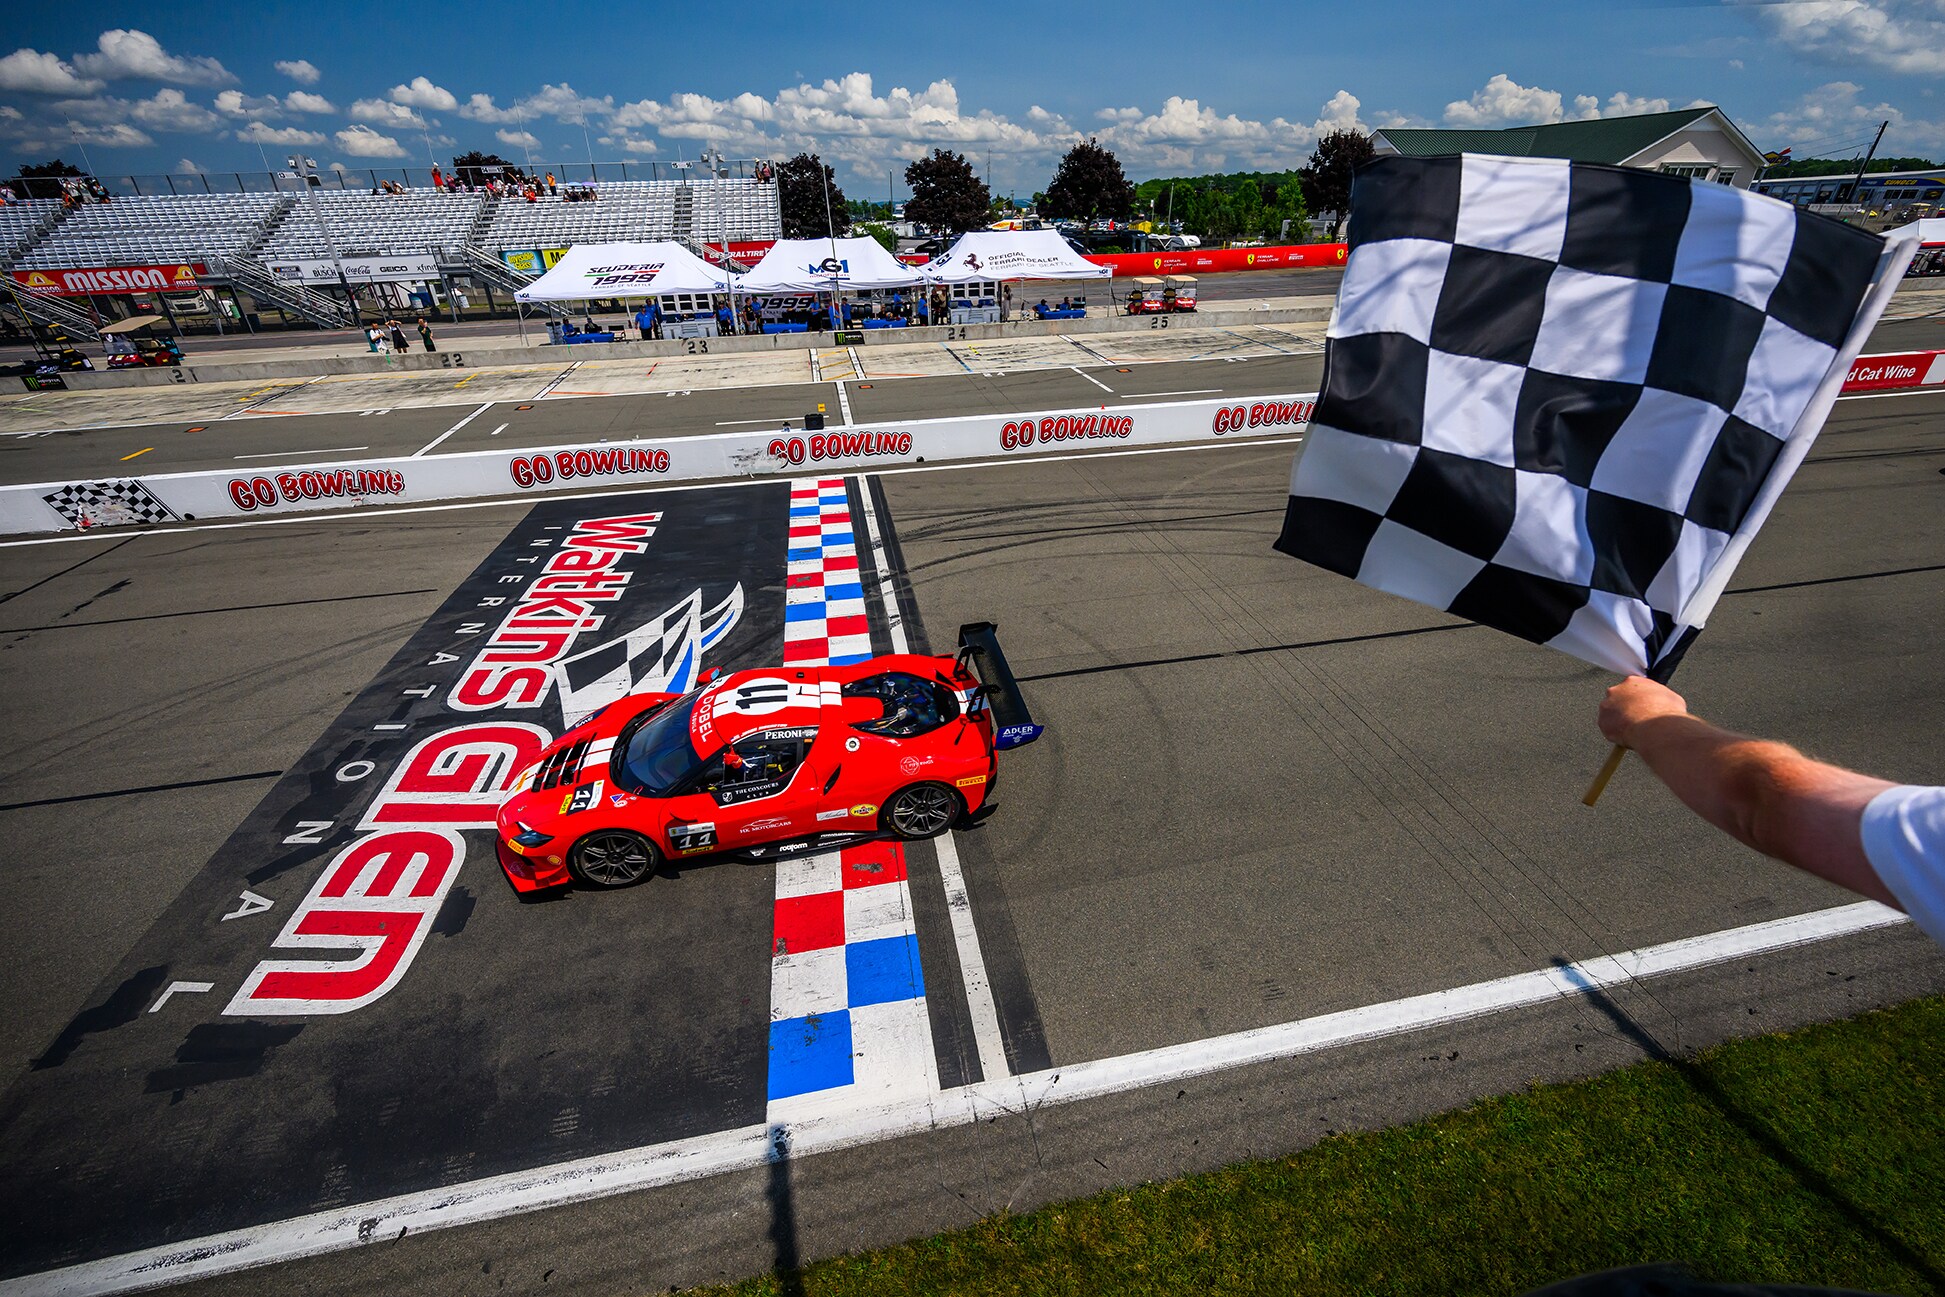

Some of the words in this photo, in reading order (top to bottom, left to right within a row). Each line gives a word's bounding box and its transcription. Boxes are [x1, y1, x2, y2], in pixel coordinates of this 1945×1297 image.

[988, 251, 1026, 260] OFFICIAL
[989, 257, 1025, 265] FERRARI
[312, 269, 337, 277] BUSCH
[379, 265, 408, 273] GEICO
[416, 263, 438, 273] xfinit
[587, 262, 665, 274] SCUDERIA
[809, 257, 849, 275] MG1
[63, 269, 169, 293] MISSION
[174, 279, 198, 288] MISSI
[593, 273, 657, 285] 1999
[762, 298, 814, 310] 1999
[1151, 317, 1169, 329] 25
[948, 327, 966, 340] 24
[687, 340, 709, 355] 23
[441, 353, 465, 368] 22
[1858, 367, 1883, 381] Cat
[1884, 365, 1917, 380] Wine
[1212, 405, 1246, 435] GO
[1247, 401, 1317, 429] BOWLI
[999, 420, 1035, 451] GO
[1039, 414, 1134, 443] BOWLING
[767, 437, 806, 469] GO
[808, 430, 913, 462] BOWLING
[510, 456, 554, 488] GO
[555, 448, 671, 480] BOWLING
[228, 476, 279, 512] GO
[275, 468, 406, 504] BOWLING
[448, 512, 663, 712] Watkins
[735, 684, 788, 710] 11
[699, 695, 715, 742] DOBEL
[765, 730, 803, 739] PERONI
[1003, 726, 1034, 736] ADLER
[149, 526, 562, 1013] INTERNATIONAL
[748, 782, 779, 793] CONCOURS
[570, 790, 592, 811] 11
[751, 821, 792, 832] MOTORCARS
[679, 833, 712, 849] 11
[221, 722, 554, 1016] Glen
